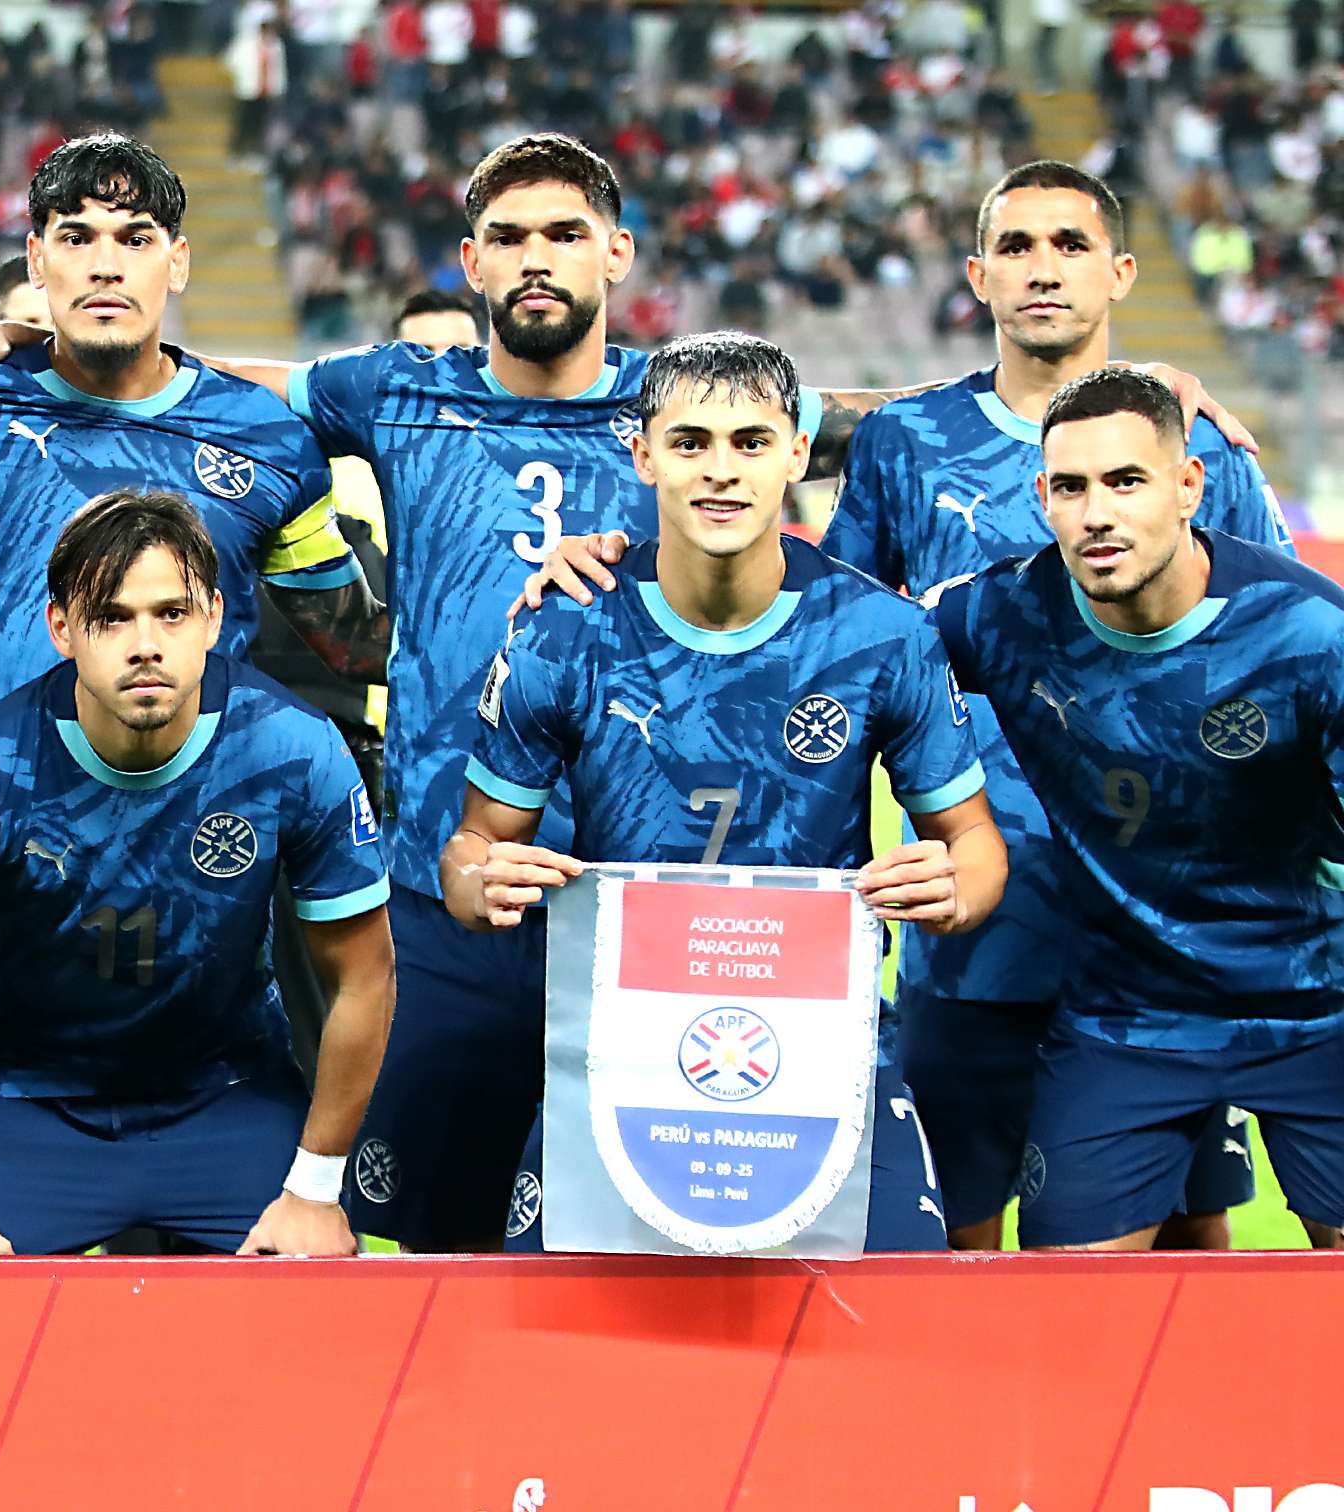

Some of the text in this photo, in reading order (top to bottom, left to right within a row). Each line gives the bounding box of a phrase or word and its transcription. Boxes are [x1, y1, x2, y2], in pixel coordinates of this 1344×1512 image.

[512, 461, 562, 562] 3
[805, 700, 828, 712] APF
[1104, 768, 1150, 848] 9
[211, 818, 233, 830] APF
[689, 788, 740, 865] 7
[689, 916, 784, 935] ASOCIACIÓN
[80, 906, 156, 986] 11
[688, 938, 781, 957] PARAGUAYA
[689, 959, 777, 979] DE FÚTBOL
[715, 1015, 747, 1029] APF
[706, 1083, 750, 1096] PARAGUAY
[650, 1123, 797, 1149] PERÚ vs PARAGUAY
[891, 1098, 936, 1190] 7
[689, 1184, 715, 1199] Lima
